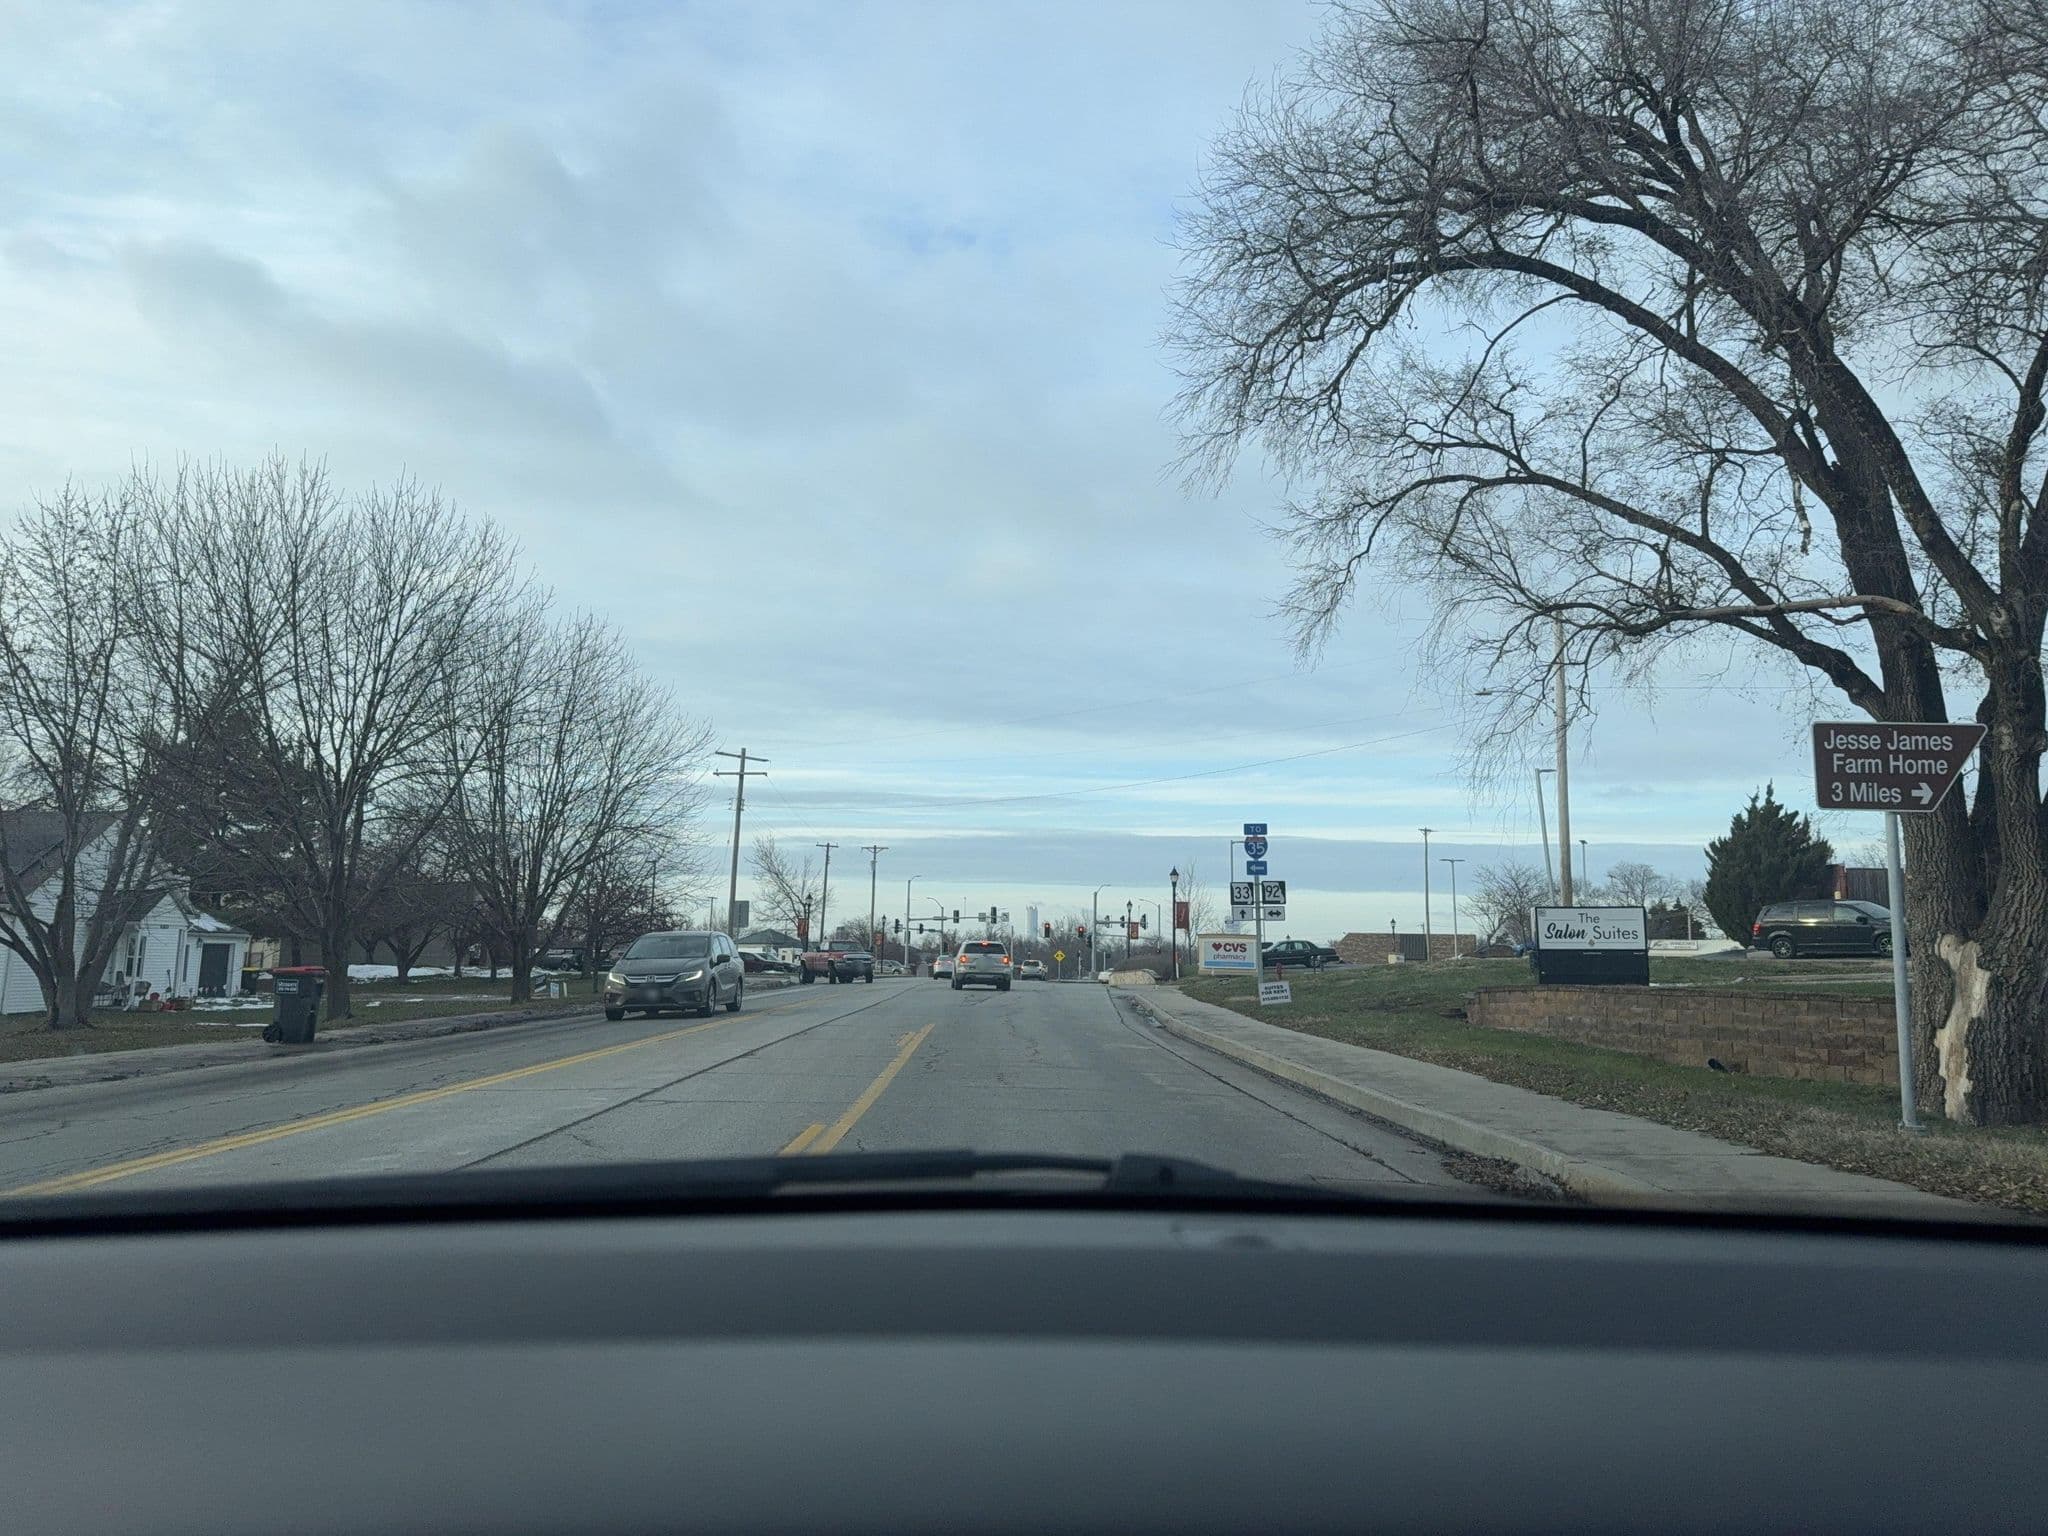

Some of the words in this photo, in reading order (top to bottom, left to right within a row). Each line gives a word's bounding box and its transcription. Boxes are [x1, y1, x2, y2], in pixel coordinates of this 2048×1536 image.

[1824, 729, 1881, 750] Jesse
[1887, 730, 1953, 751] James
[1833, 753, 1882, 774] Farm
[1889, 754, 1949, 775] Home
[1831, 782, 1843, 802] 3
[1850, 782, 1902, 803] Miles
[1247, 843, 1265, 855] 35
[1235, 886, 1250, 899] 33
[1265, 885, 1280, 898] 92
[1578, 912, 1600, 924] The
[1544, 922, 1587, 940] Salon
[1593, 925, 1639, 940] Suites
[1223, 942, 1247, 953] CVS
[1213, 952, 1246, 961] pharmacy
